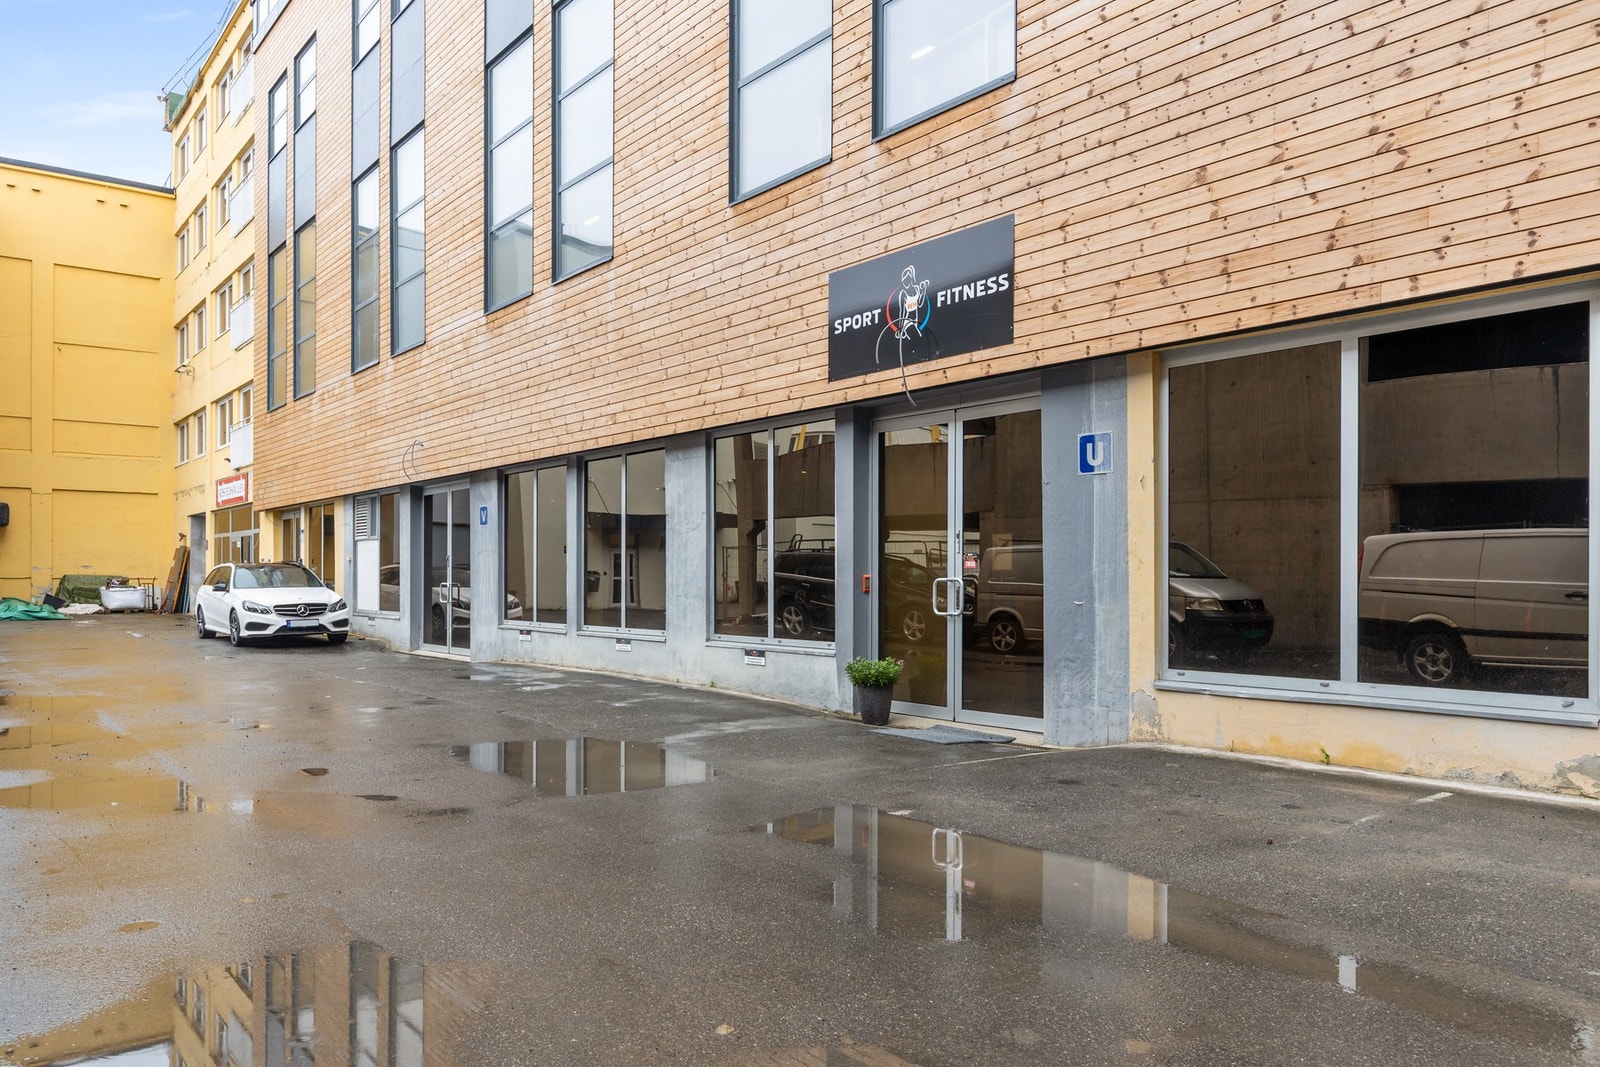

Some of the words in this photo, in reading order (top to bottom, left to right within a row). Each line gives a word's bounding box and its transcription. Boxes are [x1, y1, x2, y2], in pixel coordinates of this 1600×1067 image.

[834, 308, 882, 335] SPORT
[936, 273, 1010, 307] FITNESS
[1086, 441, 1104, 467] U
[480, 510, 487, 523] V
